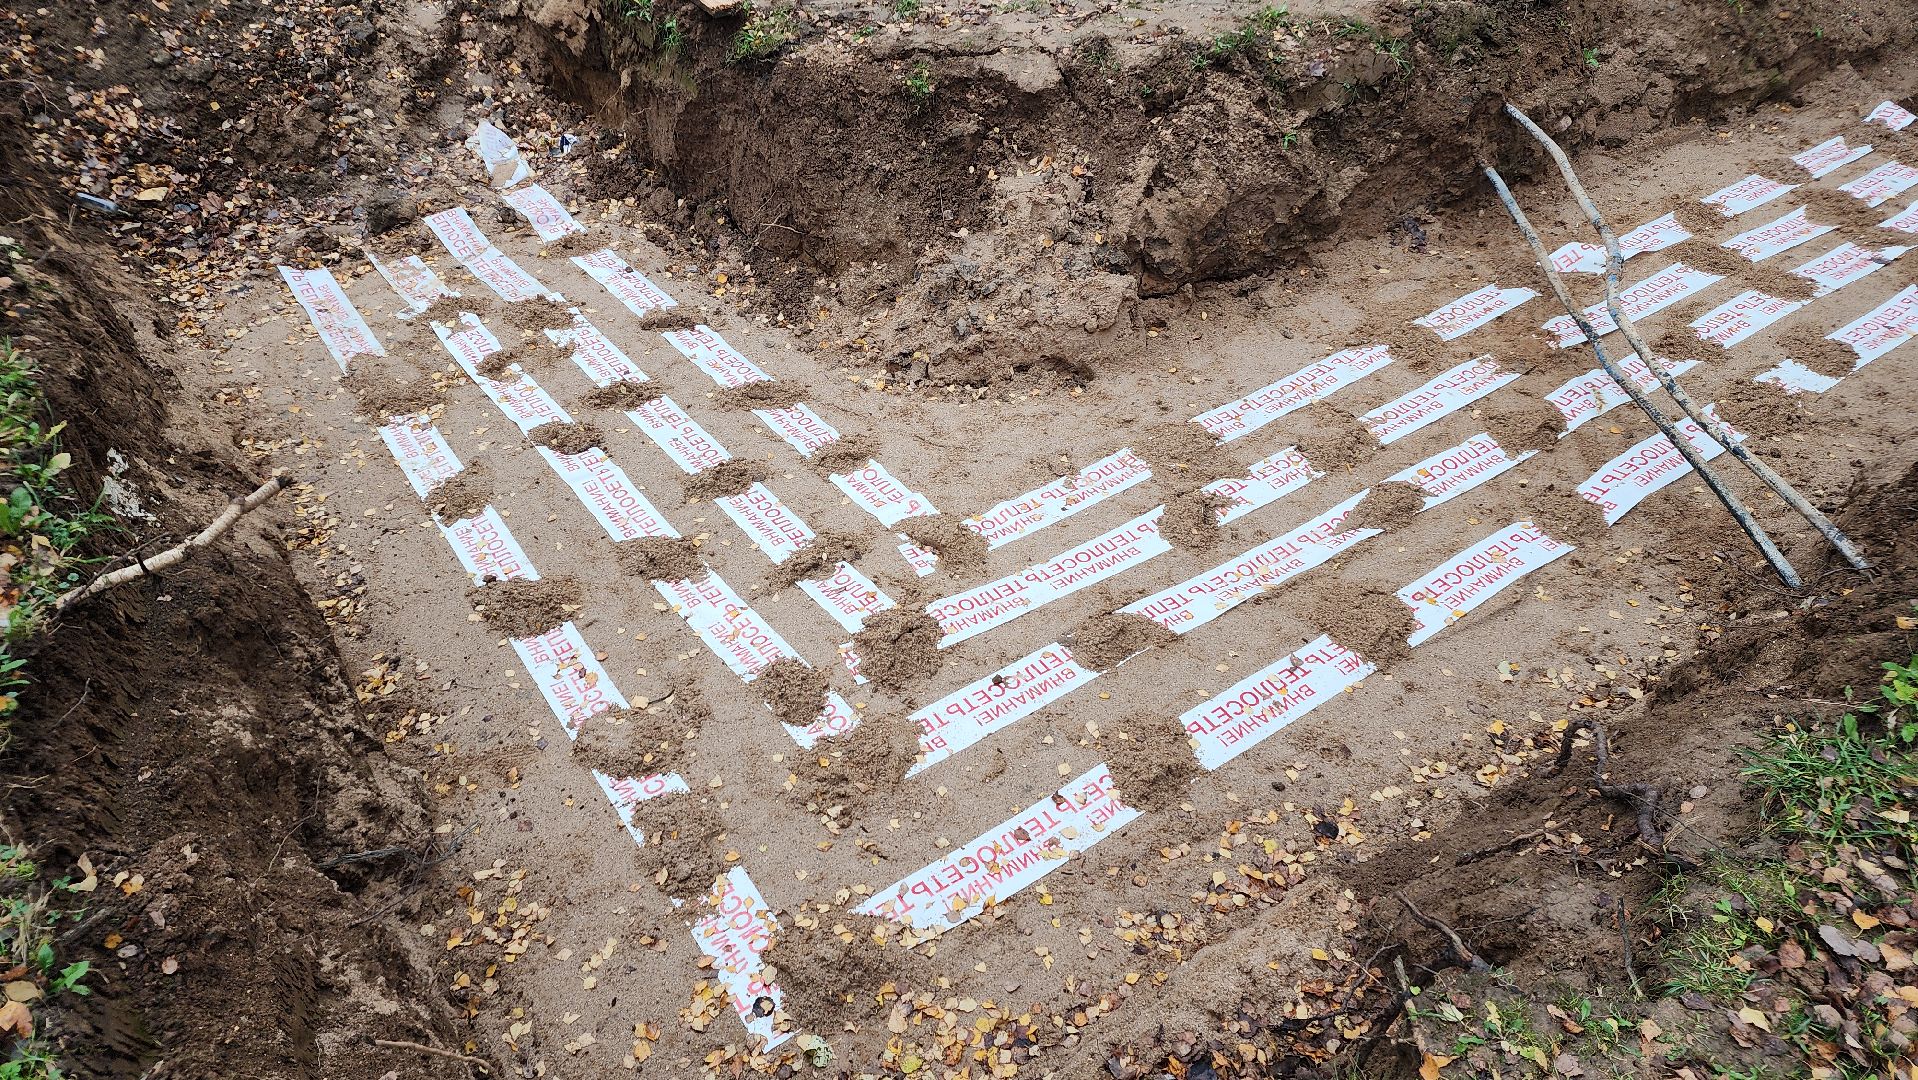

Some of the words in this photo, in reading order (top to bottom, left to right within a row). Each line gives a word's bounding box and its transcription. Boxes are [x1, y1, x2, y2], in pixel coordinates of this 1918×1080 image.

[1419, 287, 1505, 329] ТЕПЛОСЕТ
[1618, 281, 1691, 317] ВНИМАНИЕ
[1837, 301, 1914, 345] ТЕПЛОСЕТ
[643, 394, 690, 430] ТЕПЛО
[1234, 361, 1339, 414] ТЕПЛОСЕТЬ
[674, 424, 726, 466] ЛОСЕТЬ
[1406, 436, 1500, 487] ТЕПЛОСЕТ
[1424, 452, 1506, 496] ВНИМАНИЕ
[1596, 425, 1696, 490] ТПЛОСЕТЬ
[592, 466, 663, 537] ТЕПЛОСЕТЬ
[1037, 451, 1141, 504] ЕПЛОСЕТЬ
[578, 477, 640, 539] ВНИМАНИЕ!
[738, 483, 813, 549] ТЕПЛОСЕТ
[964, 494, 1044, 536] ТЕПЛОС
[450, 523, 503, 583] НИМАНИЕ!
[463, 509, 527, 582] ТЕПЛОСЕТ
[1021, 526, 1143, 587] ТЕПЛОСЕТЬ
[1046, 544, 1142, 592] ВНИМАНИЕ!
[1183, 539, 1303, 601] ТЕПЛОСЕТЬ
[1407, 535, 1518, 609] ТЕПЛОСЕТЬ
[807, 572, 859, 617] ВНИМА
[926, 572, 1029, 626] ТЕПЛОСЕ
[1212, 556, 1306, 603] ВНИМАНИЕ!
[1438, 553, 1526, 612] ВНИМАНИЕ!
[716, 598, 788, 667] ПЛОСЕТЬ
[933, 590, 1028, 639] ВНИМАН
[706, 617, 768, 677] НИМАНИЕ!
[942, 645, 1073, 721] ТЕПЛОСЕТЬ
[971, 666, 1078, 727] ВНИМАНИЕ!
[1182, 657, 1311, 741] ТЕПЛОСЕТЬ
[1215, 682, 1316, 748] ВНИМАНИЕ!
[906, 806, 1062, 904] ТЕПЛОСЕТЬ
